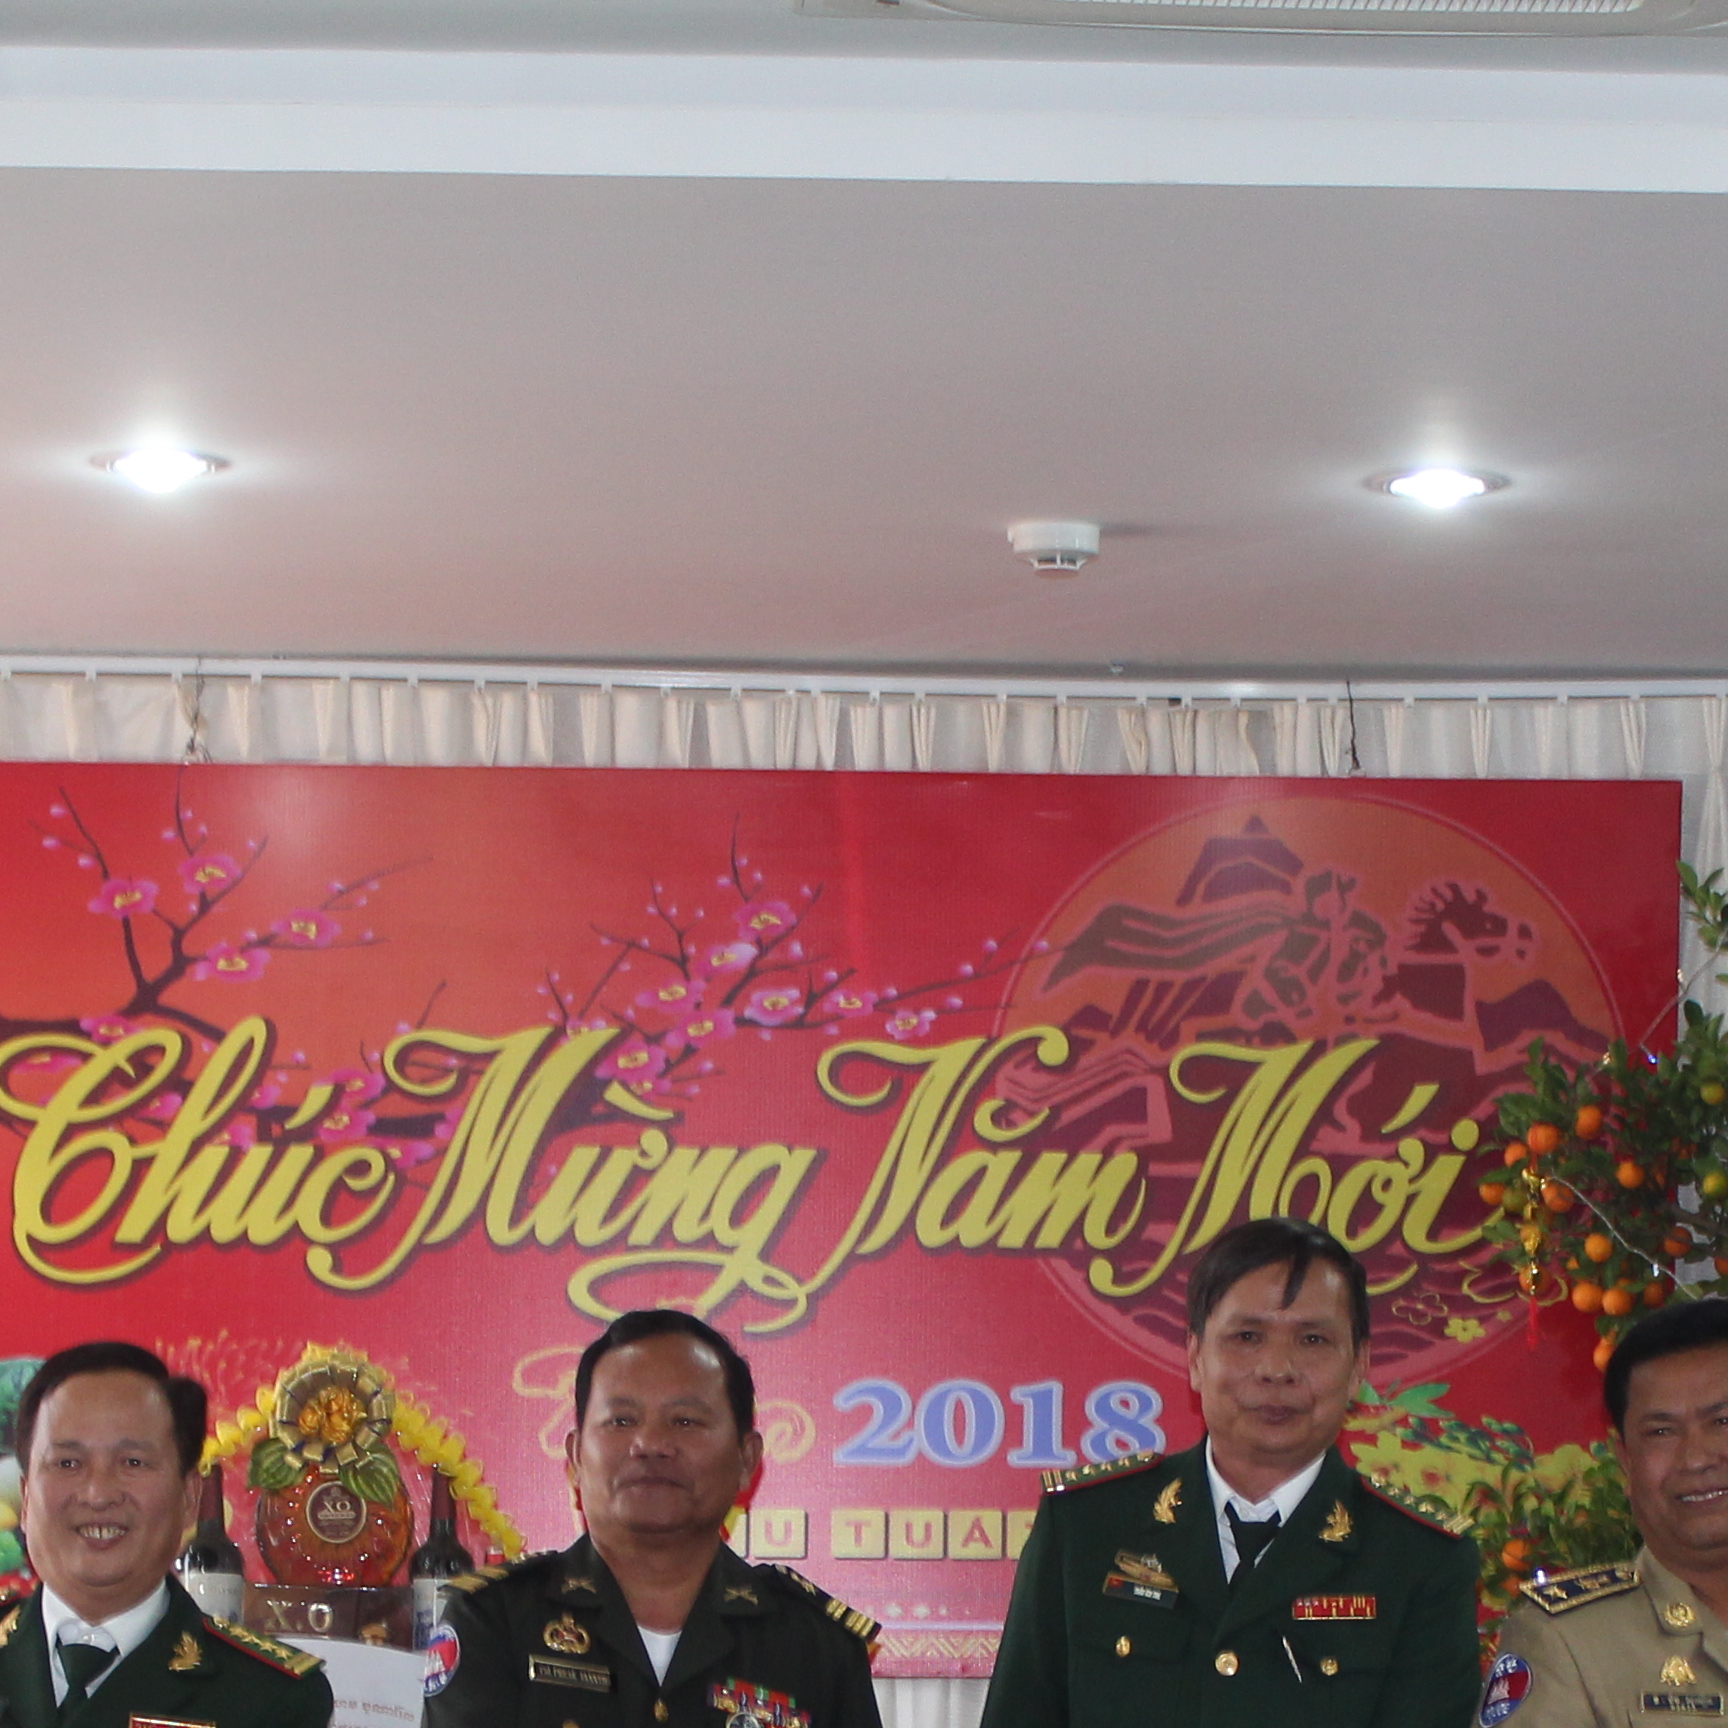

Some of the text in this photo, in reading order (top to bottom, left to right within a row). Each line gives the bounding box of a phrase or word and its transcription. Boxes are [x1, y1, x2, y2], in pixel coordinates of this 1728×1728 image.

[305, 1025, 818, 1335] Mừng
[759, 1024, 1147, 1302] Năm
[1088, 1037, 1500, 1298] Mới
[832, 1378, 1167, 1468] 2018
